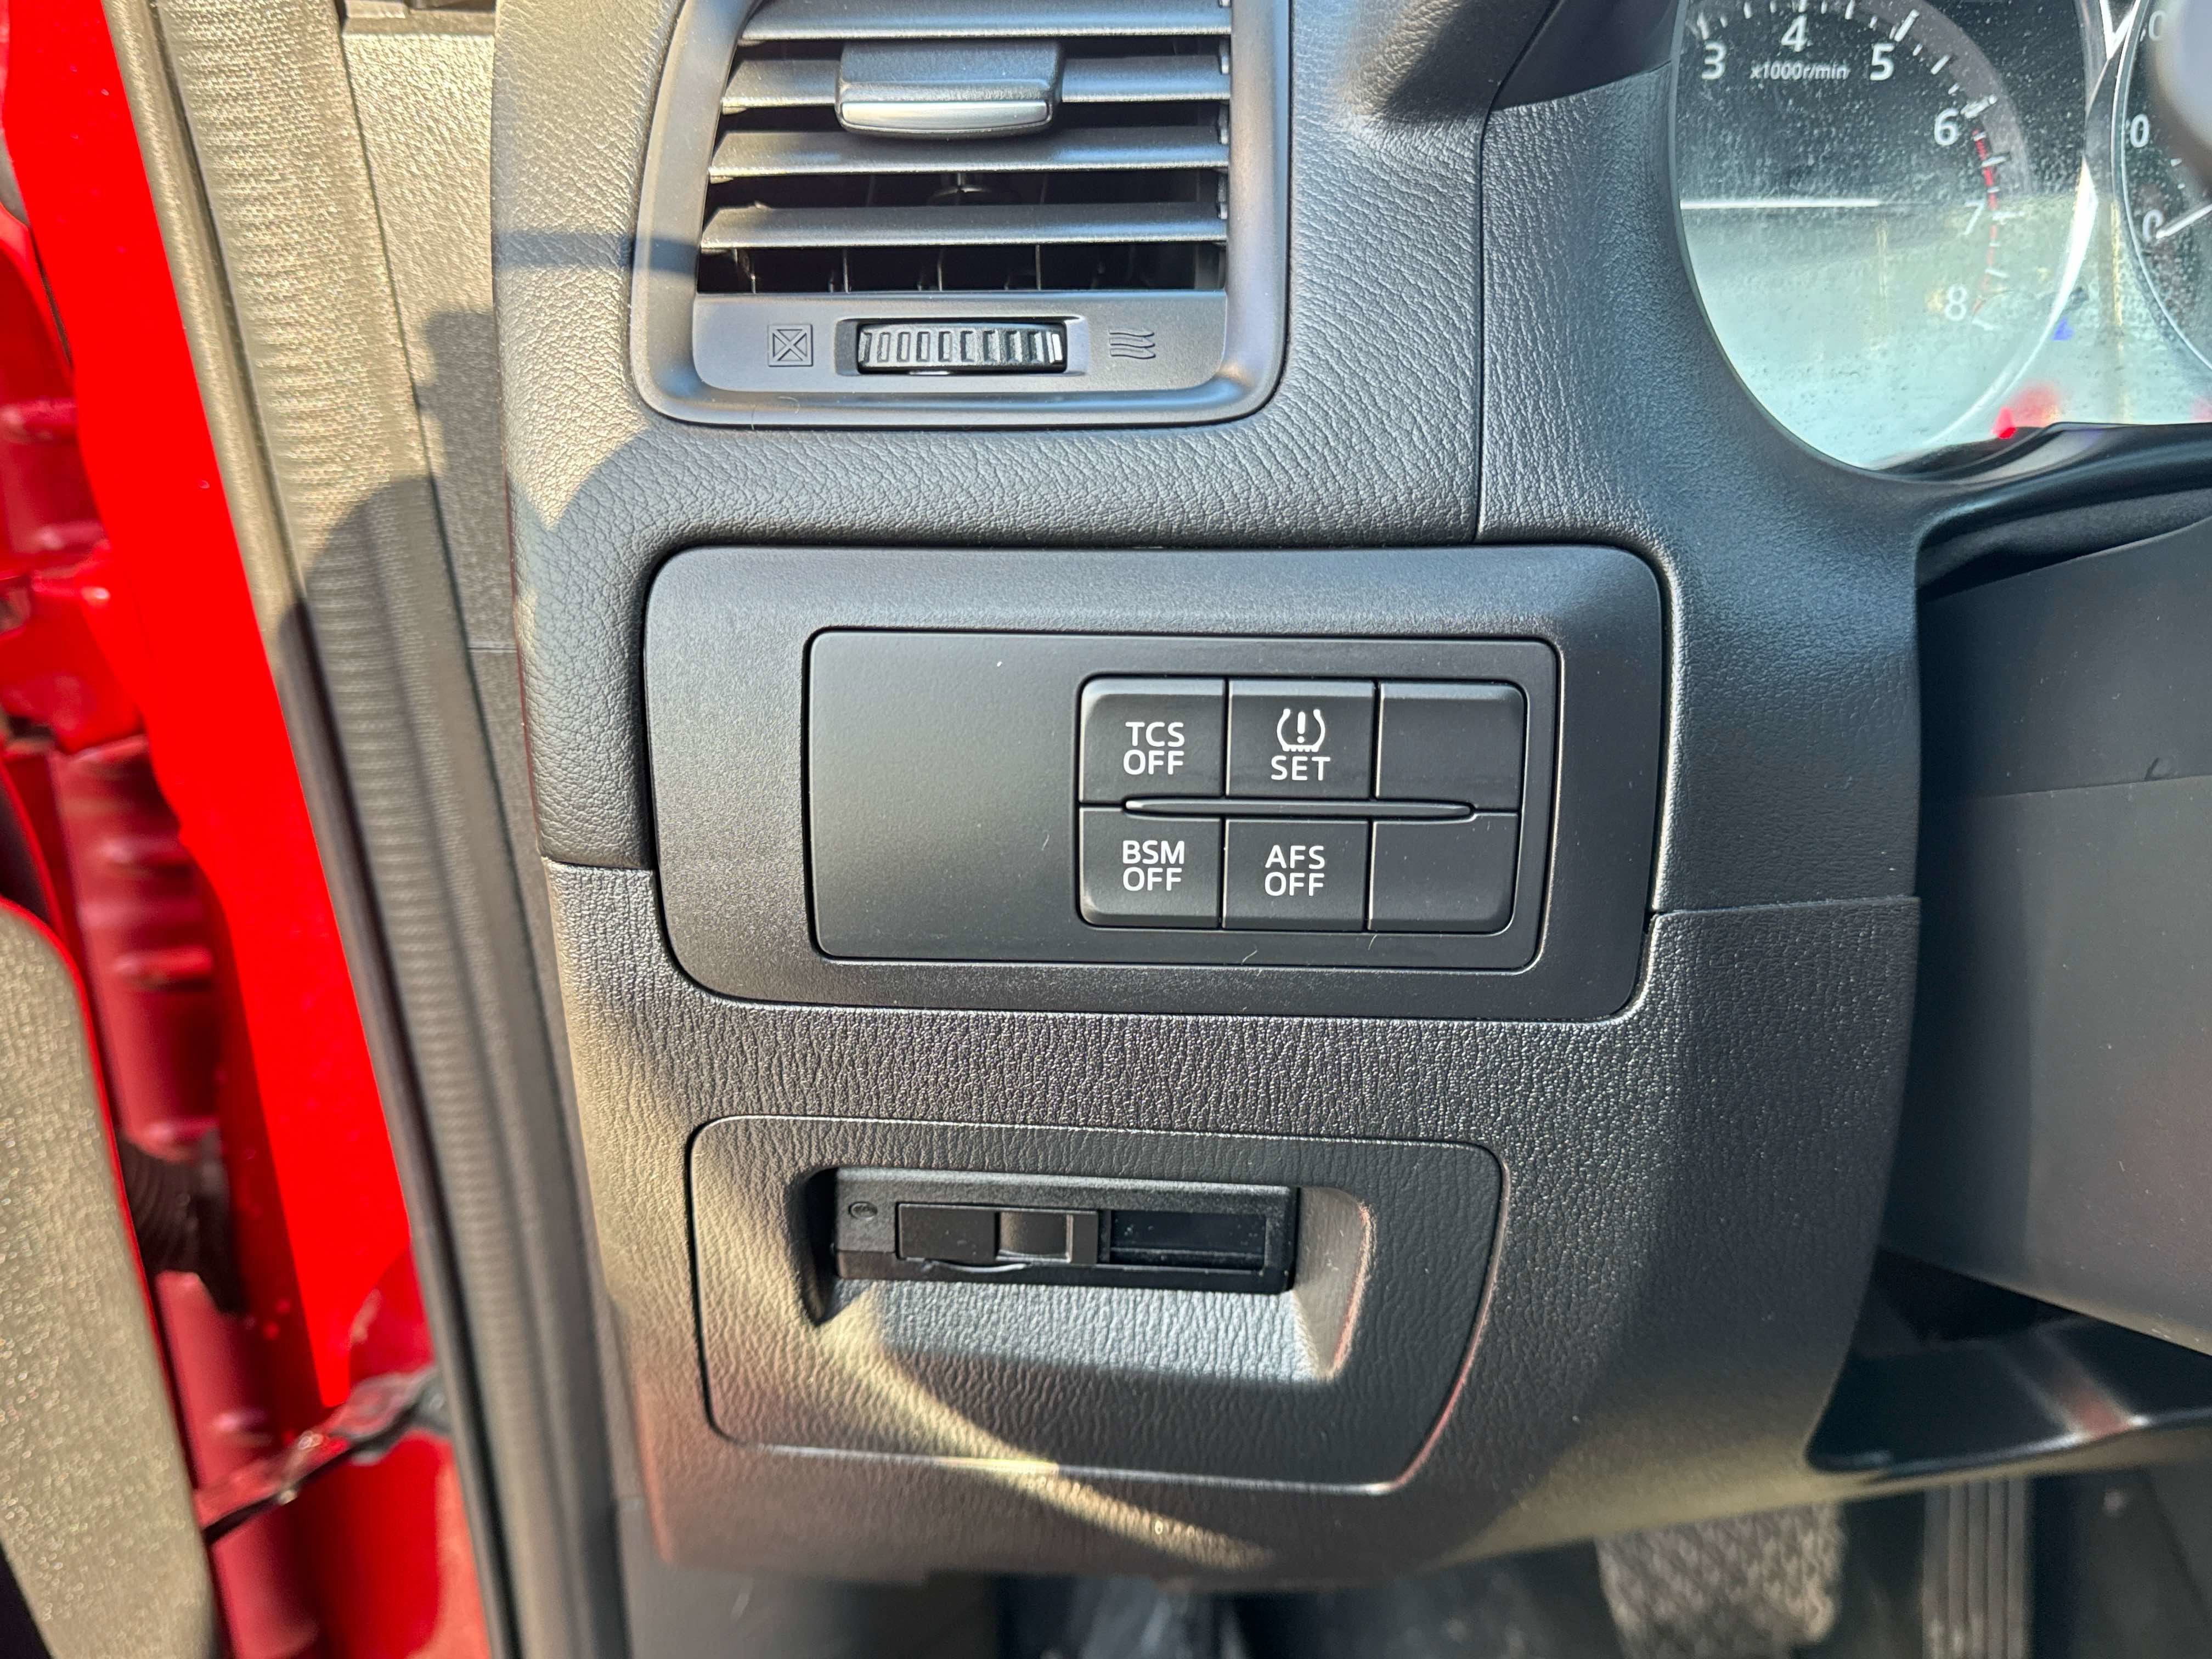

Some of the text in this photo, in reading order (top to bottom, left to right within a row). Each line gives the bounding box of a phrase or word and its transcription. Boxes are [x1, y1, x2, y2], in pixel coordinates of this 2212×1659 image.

[1781, 15, 1808, 53] 4
[1701, 41, 1727, 80] 3
[1870, 43, 1895, 81] 5
[1934, 109, 1959, 146] 6
[1964, 199, 1986, 235] 7
[1945, 285, 1967, 321] 8
[1125, 721, 1185, 747] TCS
[1123, 749, 1184, 775] OFF
[1271, 755, 1331, 781] SET
[1122, 840, 1185, 865] BSM
[1265, 844, 1325, 870] AFS
[1123, 867, 1182, 891] OFF
[1265, 871, 1325, 896] OFF
